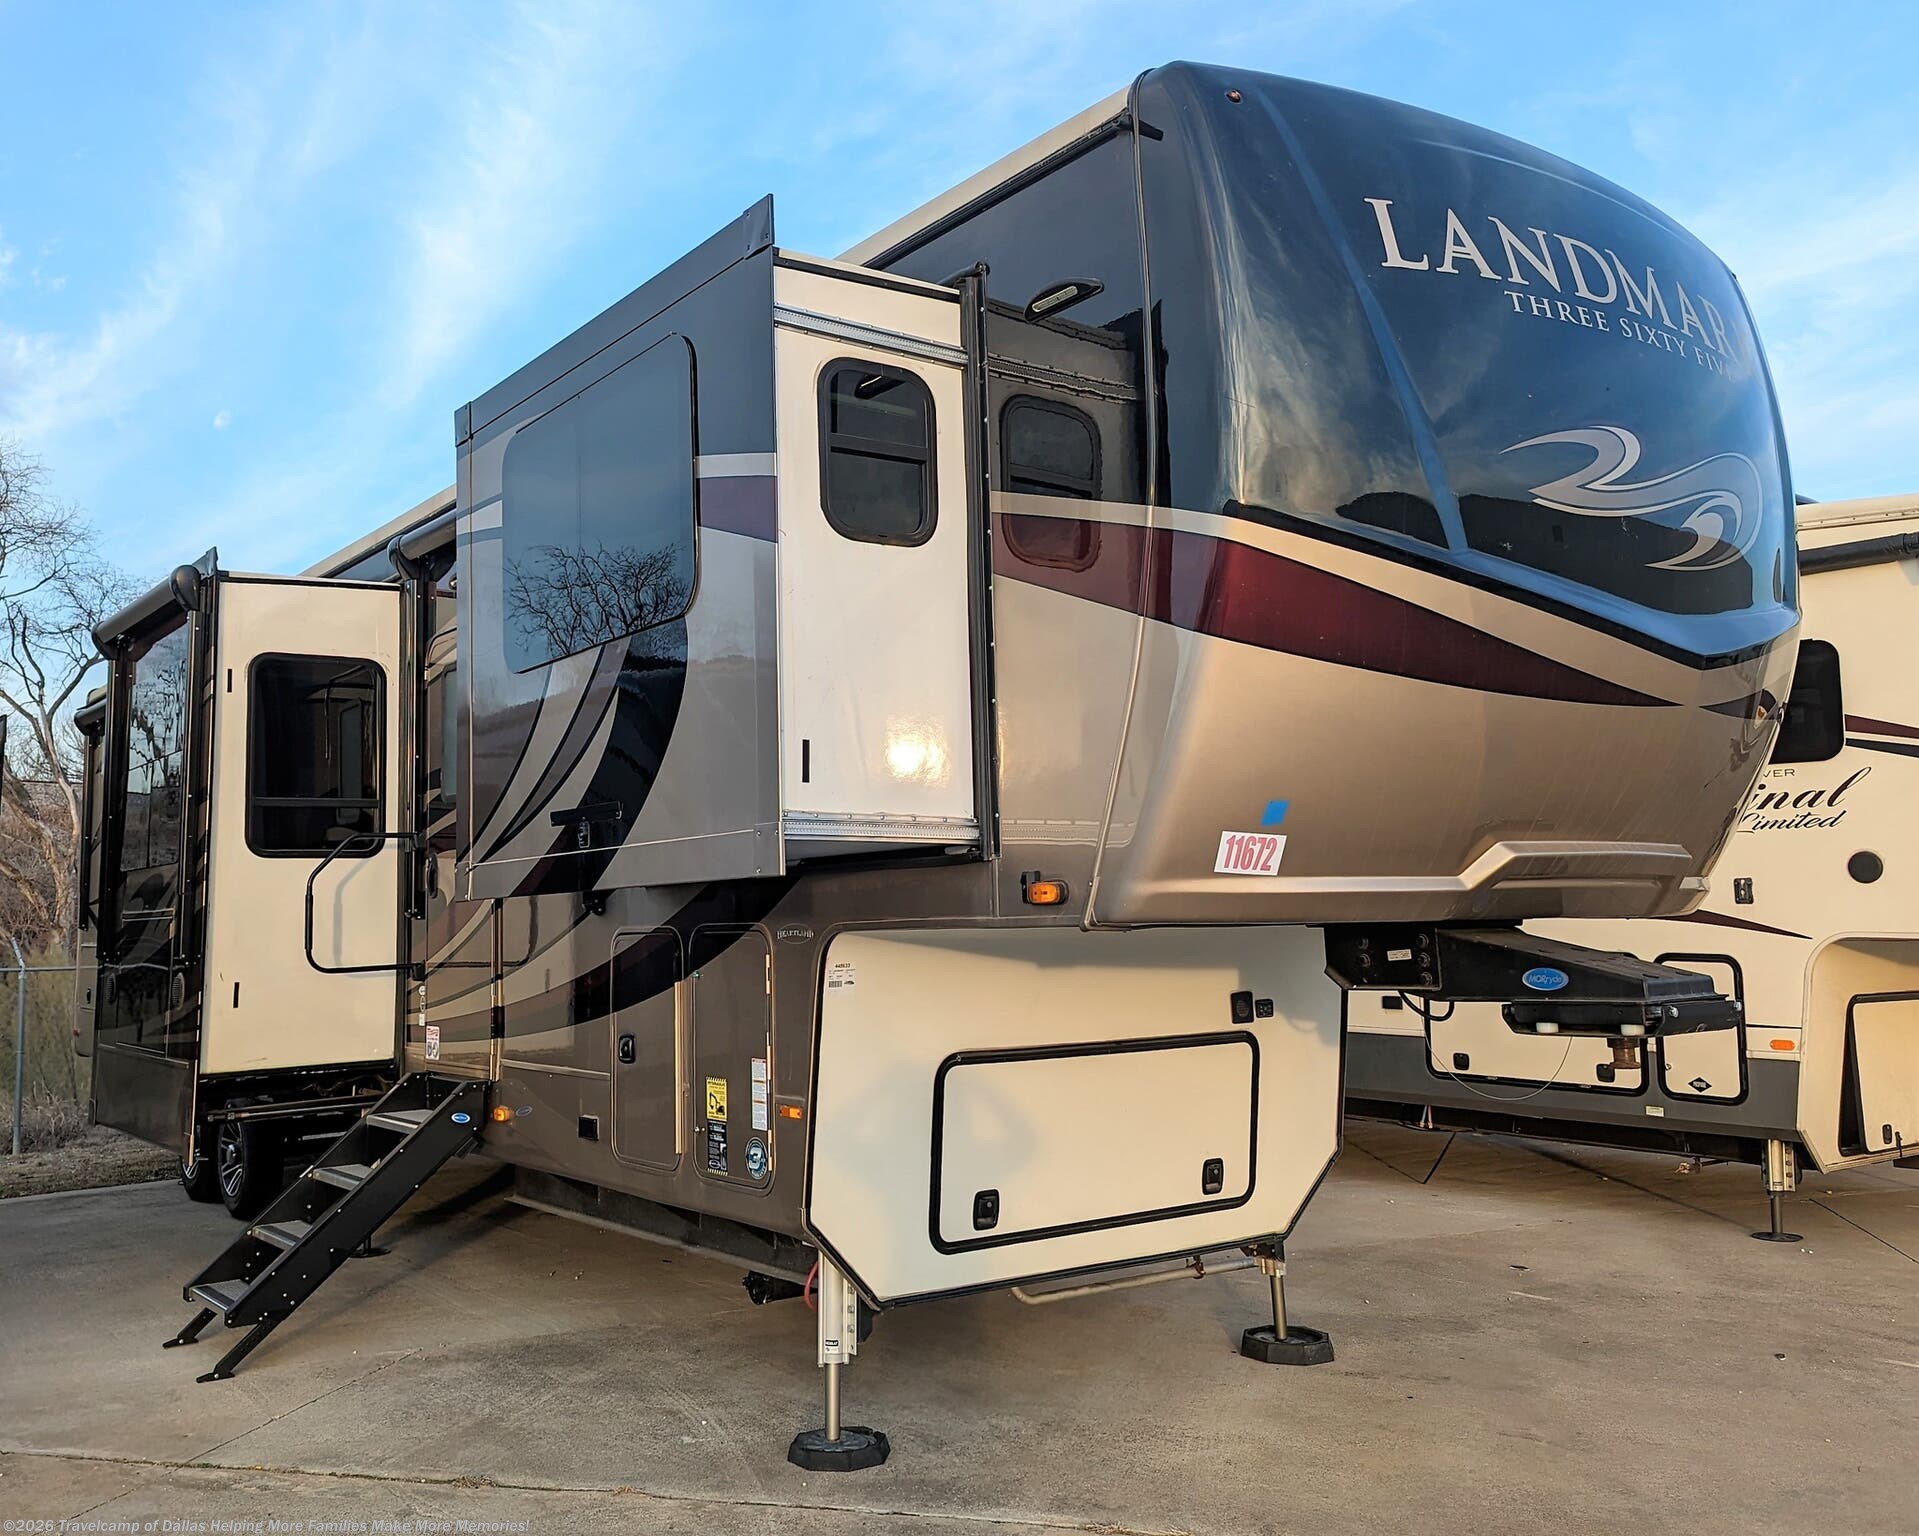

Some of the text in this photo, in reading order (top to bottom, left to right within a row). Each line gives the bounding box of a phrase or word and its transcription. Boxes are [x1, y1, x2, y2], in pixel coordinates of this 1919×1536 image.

[1364, 197, 1742, 365] LANDMAR
[1504, 290, 1732, 382] THREE SIXTY FIV
[1223, 834, 1278, 872] 11672
